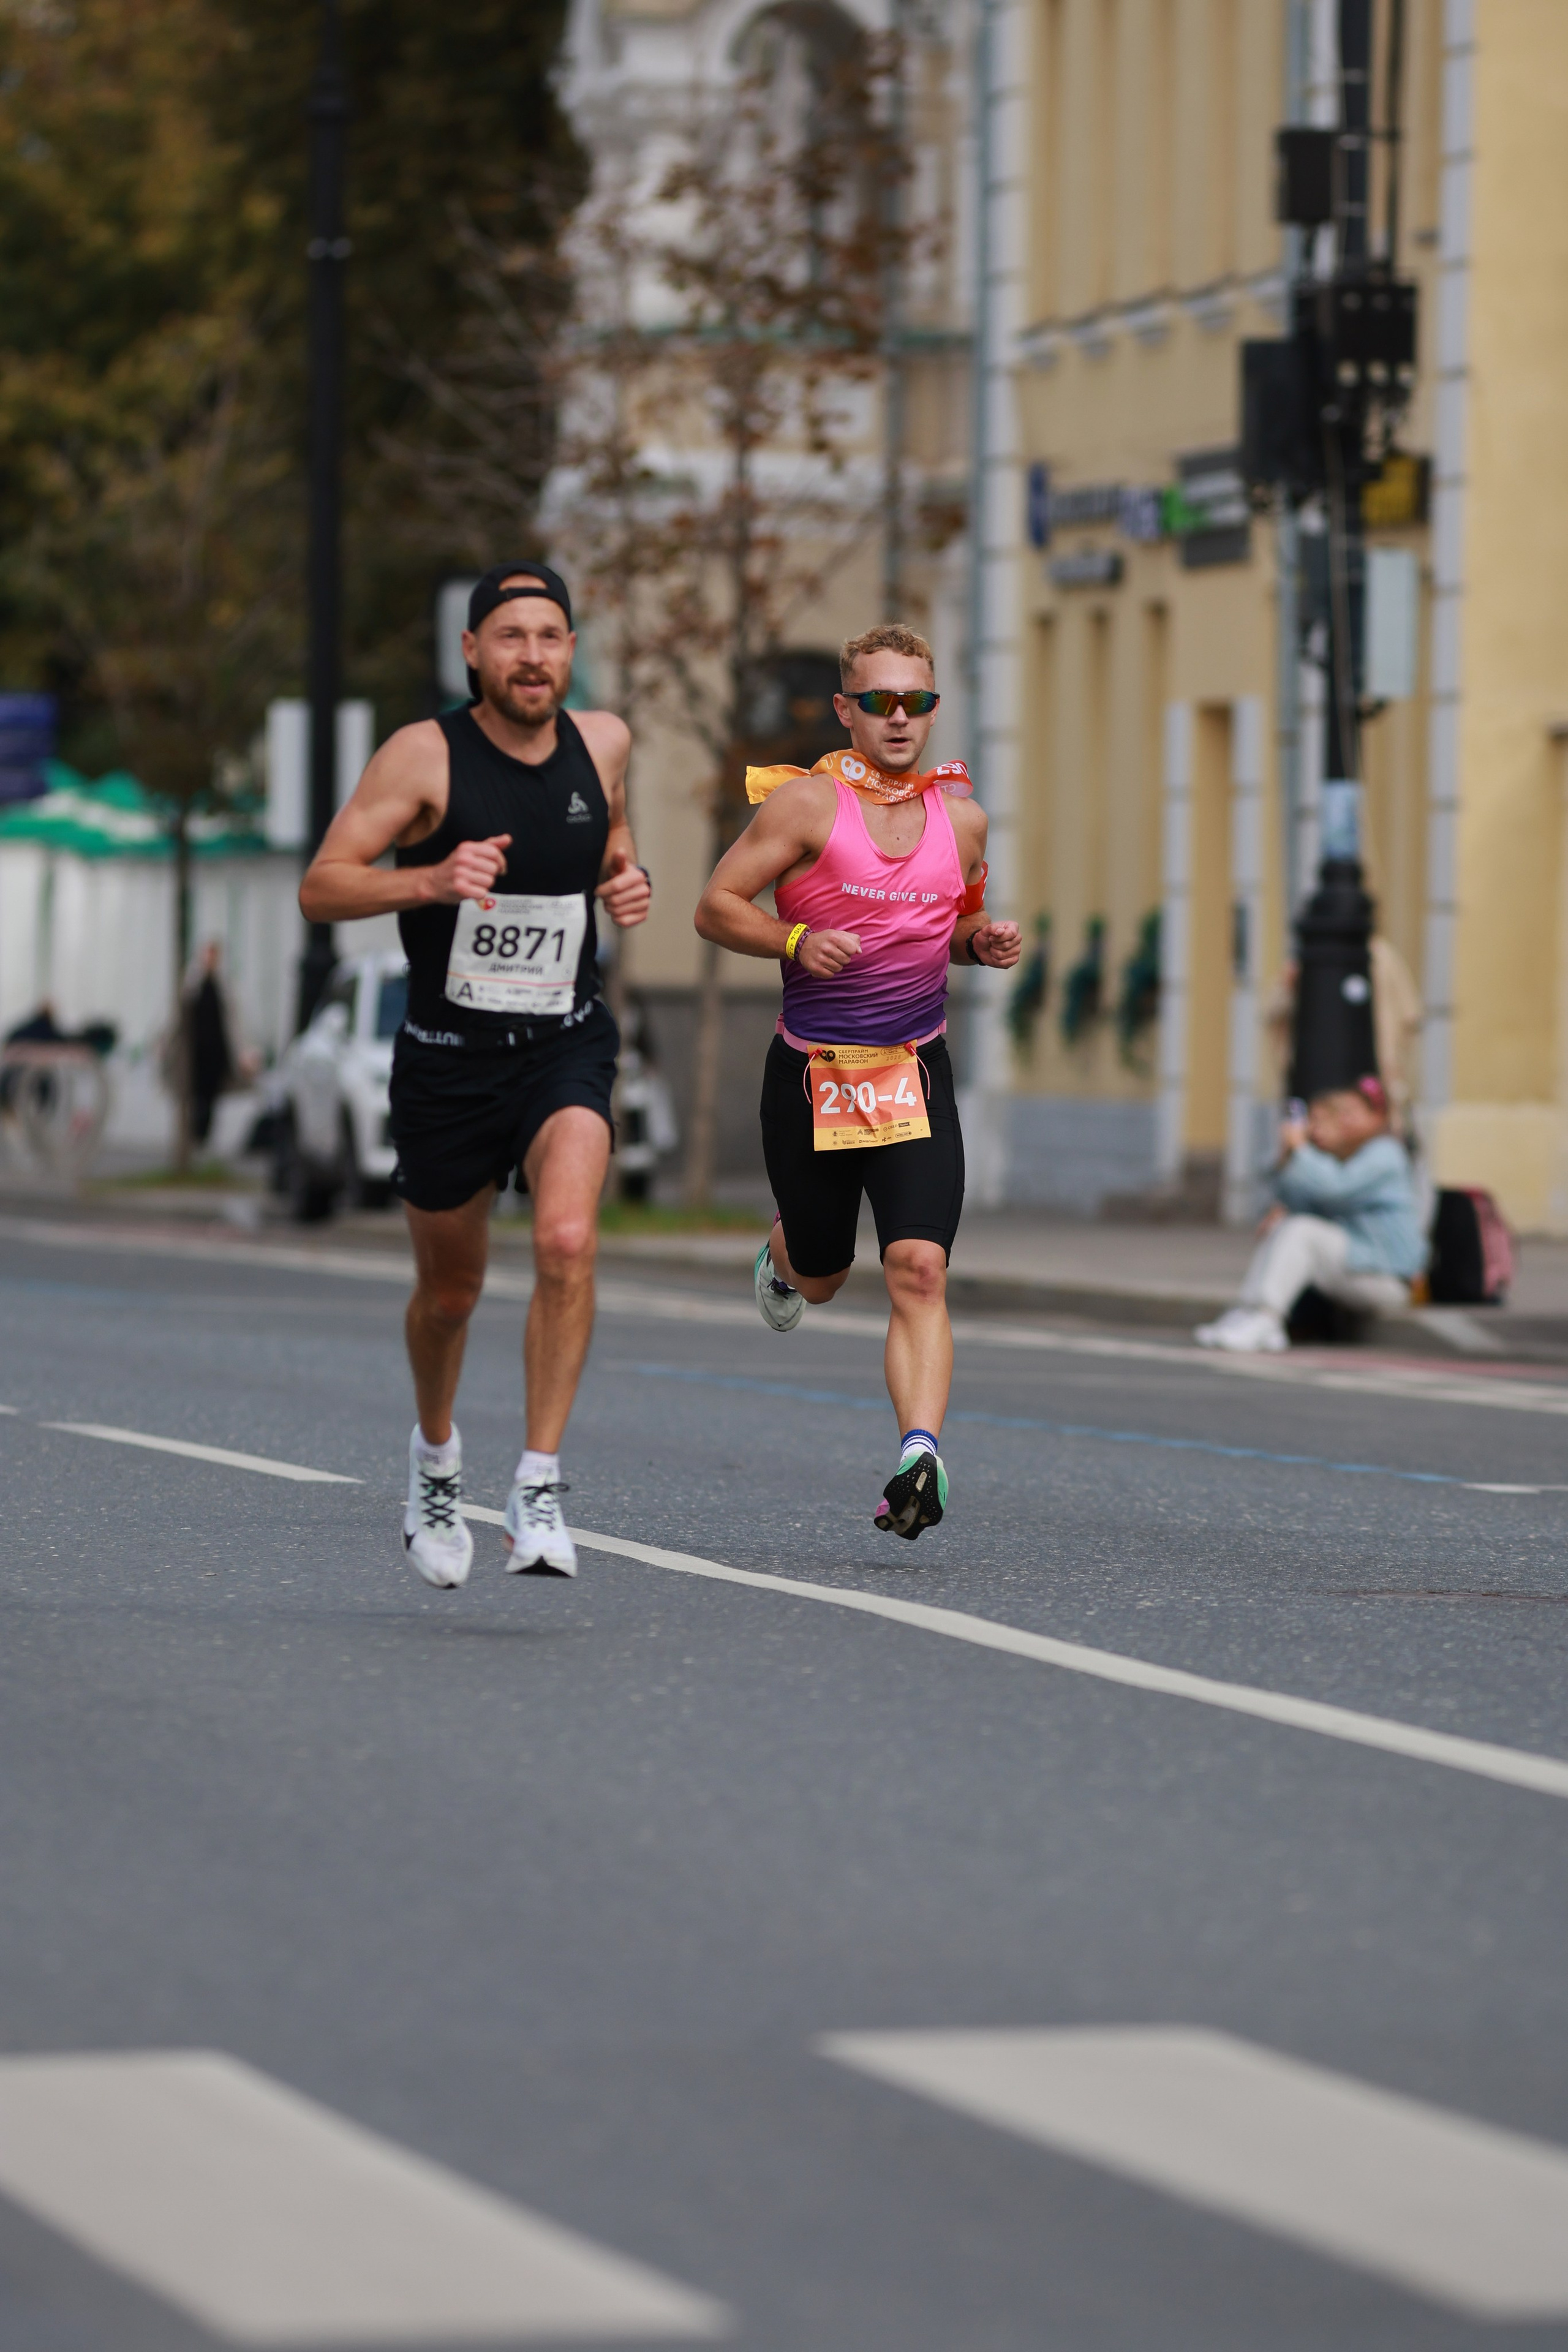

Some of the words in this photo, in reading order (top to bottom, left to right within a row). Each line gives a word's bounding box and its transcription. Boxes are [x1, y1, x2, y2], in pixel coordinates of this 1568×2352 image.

[871, 770, 914, 790] СБЕРПРАЙМ
[841, 883, 886, 901] NEVER
[889, 891, 916, 902] GIVE
[921, 893, 938, 904] UP
[791, 925, 804, 940] 290-4
[472, 924, 565, 962] 8871
[488, 963, 543, 975] ДМИТРИЙ
[819, 1077, 917, 1114] 290-4
